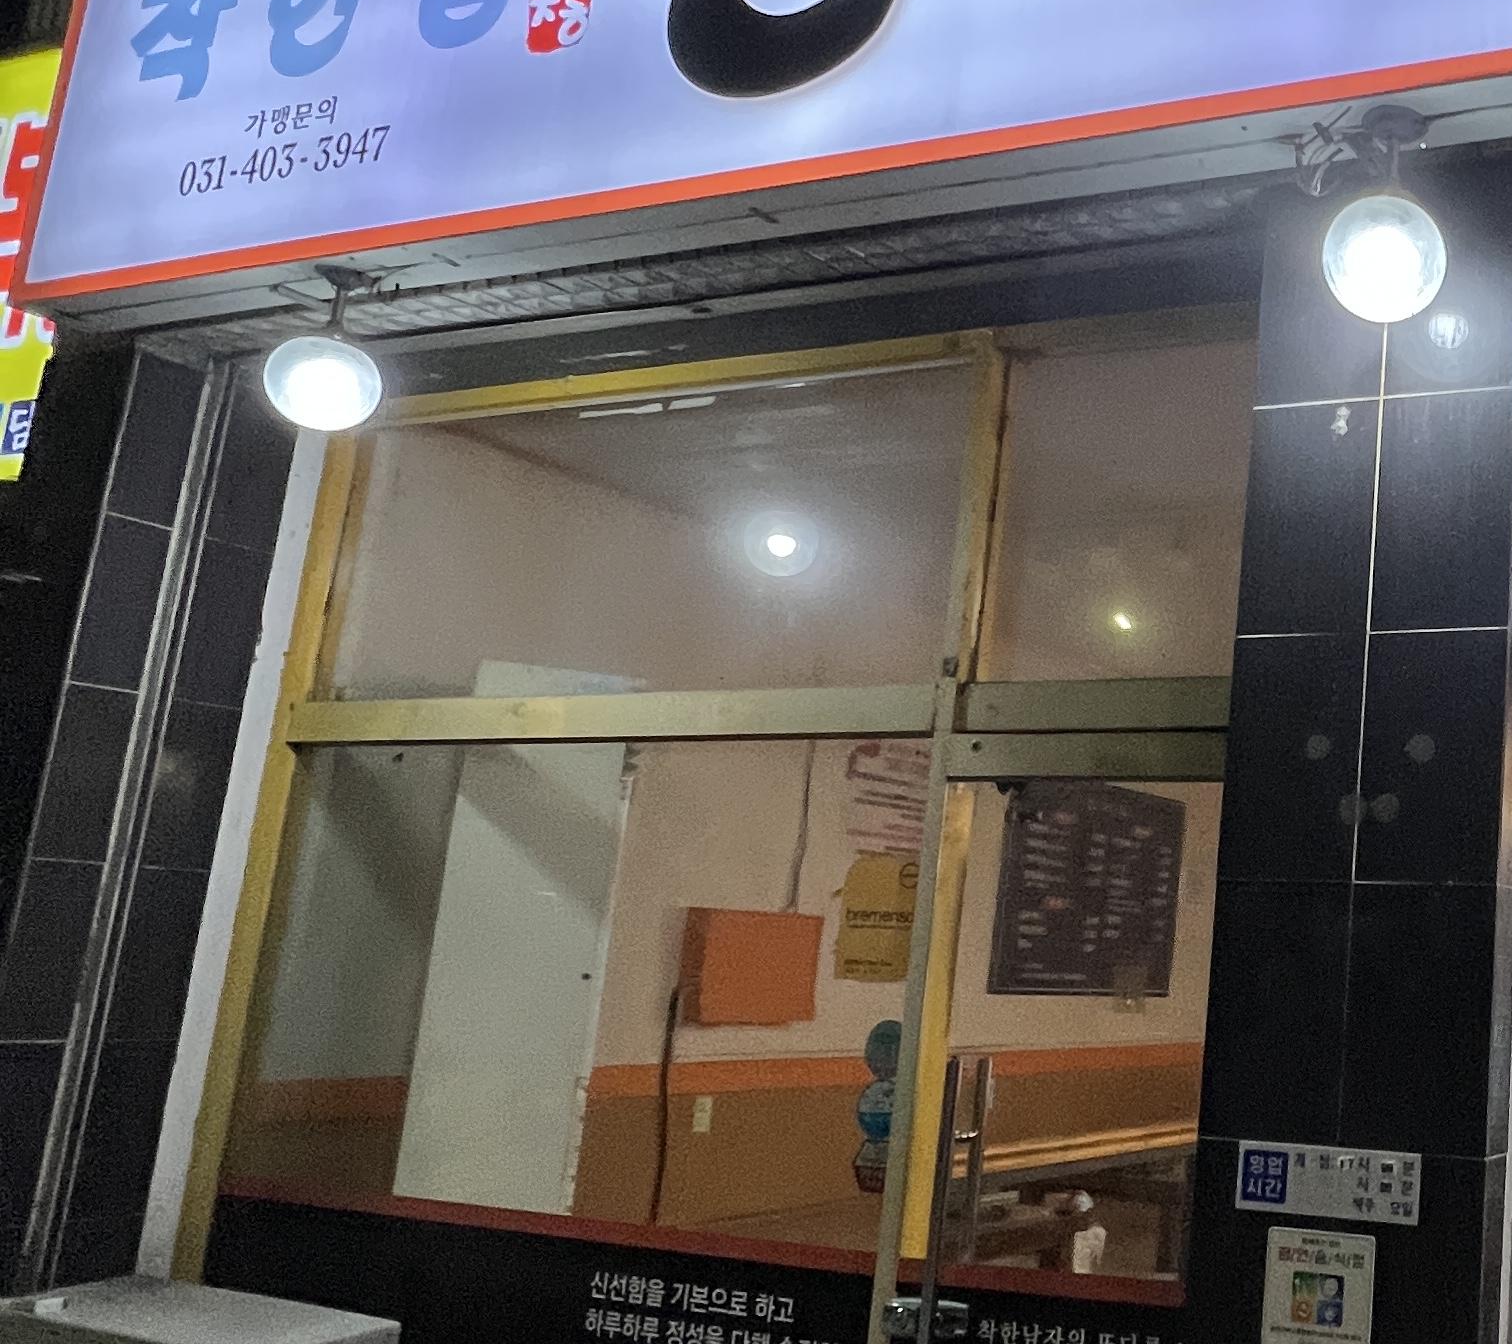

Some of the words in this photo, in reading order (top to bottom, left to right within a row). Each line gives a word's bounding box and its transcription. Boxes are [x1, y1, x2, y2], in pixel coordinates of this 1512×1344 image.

[244, 96, 338, 139] 가맹문의
[178, 125, 391, 197] 031-403-3947
[1247, 1177, 1282, 1197] 시간
[590, 1270, 665, 1308] 신선함을
[670, 1281, 748, 1318] 기본으로
[755, 1294, 795, 1324] 하고
[584, 1308, 660, 1344] 하루하루
